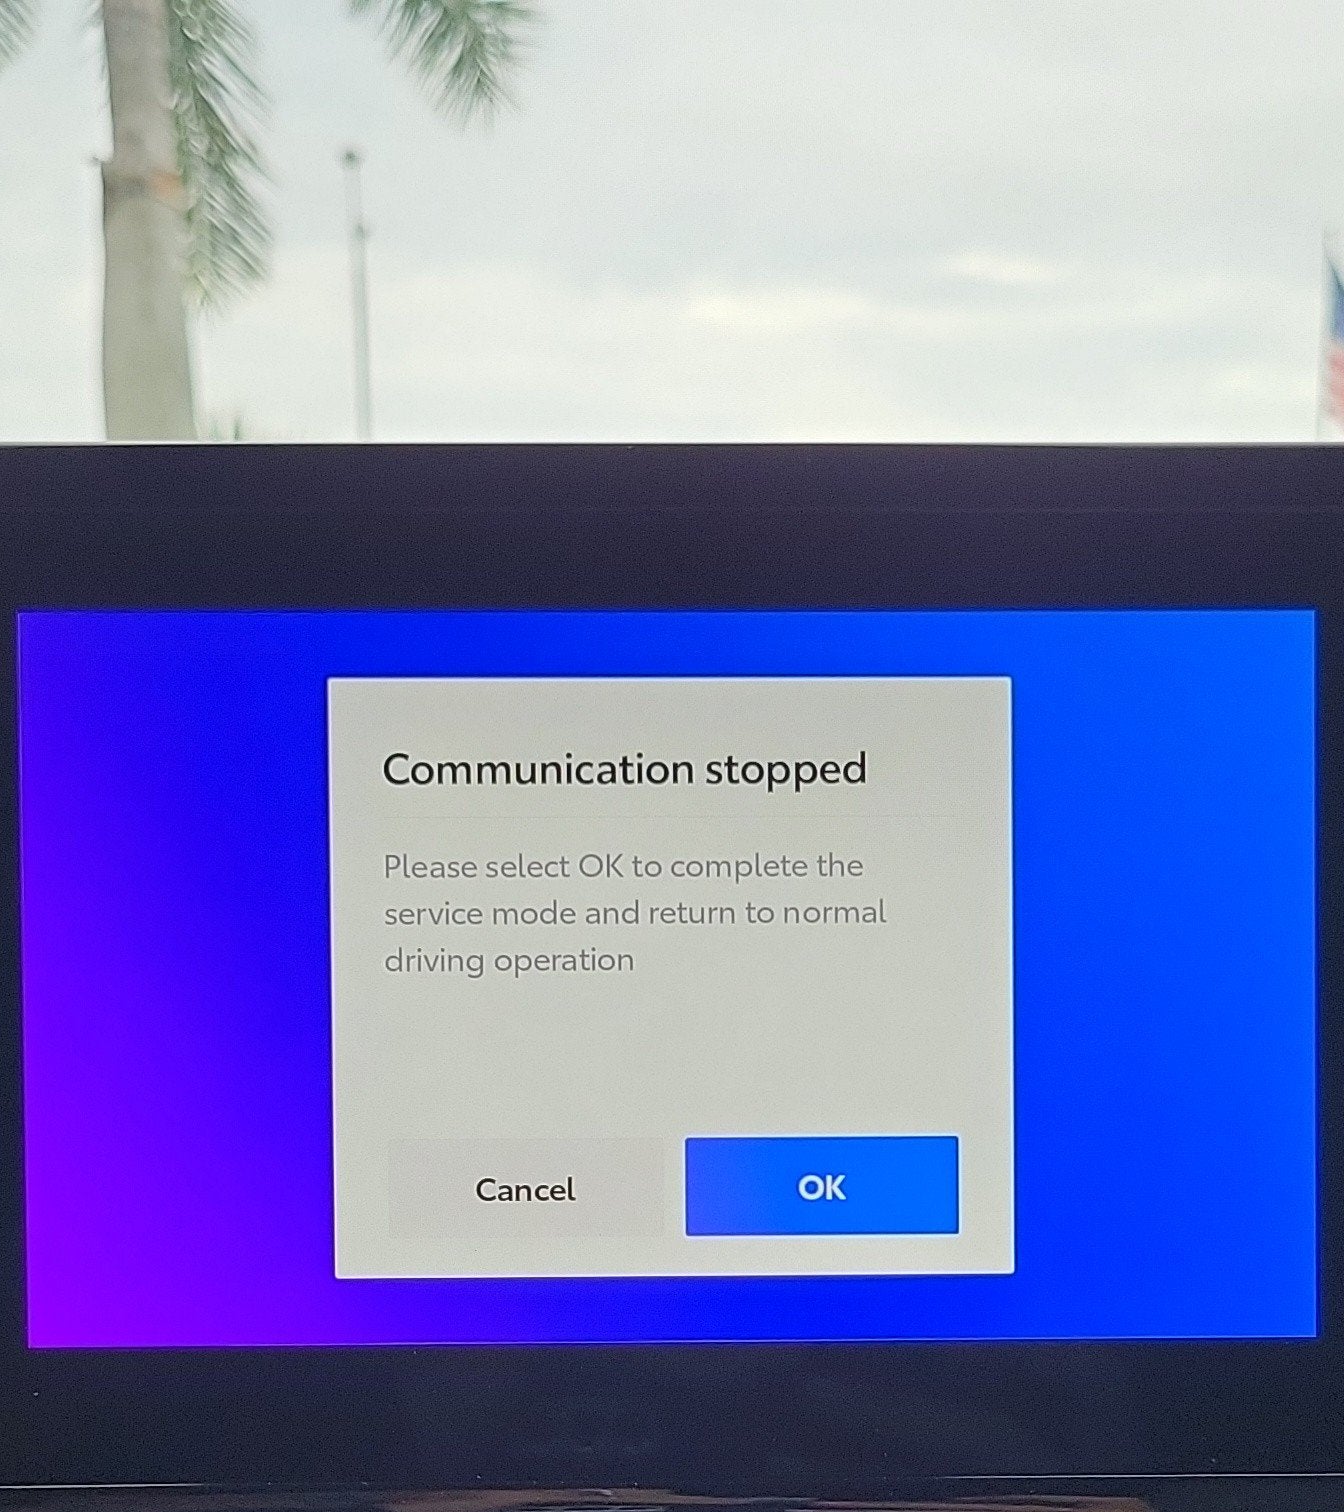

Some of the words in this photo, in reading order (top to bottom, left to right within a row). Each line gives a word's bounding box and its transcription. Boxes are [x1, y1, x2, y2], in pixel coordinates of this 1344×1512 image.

[384, 753, 693, 784] Communication
[707, 751, 865, 792] stopped
[386, 854, 477, 878] Please
[486, 853, 570, 878] select
[579, 854, 623, 877] OK
[632, 856, 662, 877] to
[671, 853, 807, 883] complete
[817, 852, 863, 876] the
[386, 901, 482, 925] service
[493, 900, 576, 924] mode
[586, 900, 639, 924] and
[650, 903, 734, 923] return
[746, 902, 774, 923] to
[784, 899, 886, 923] normal
[386, 947, 483, 978] driving
[495, 947, 633, 978] operation
[477, 1177, 575, 1201] Cancel
[799, 1175, 845, 1199] OK
